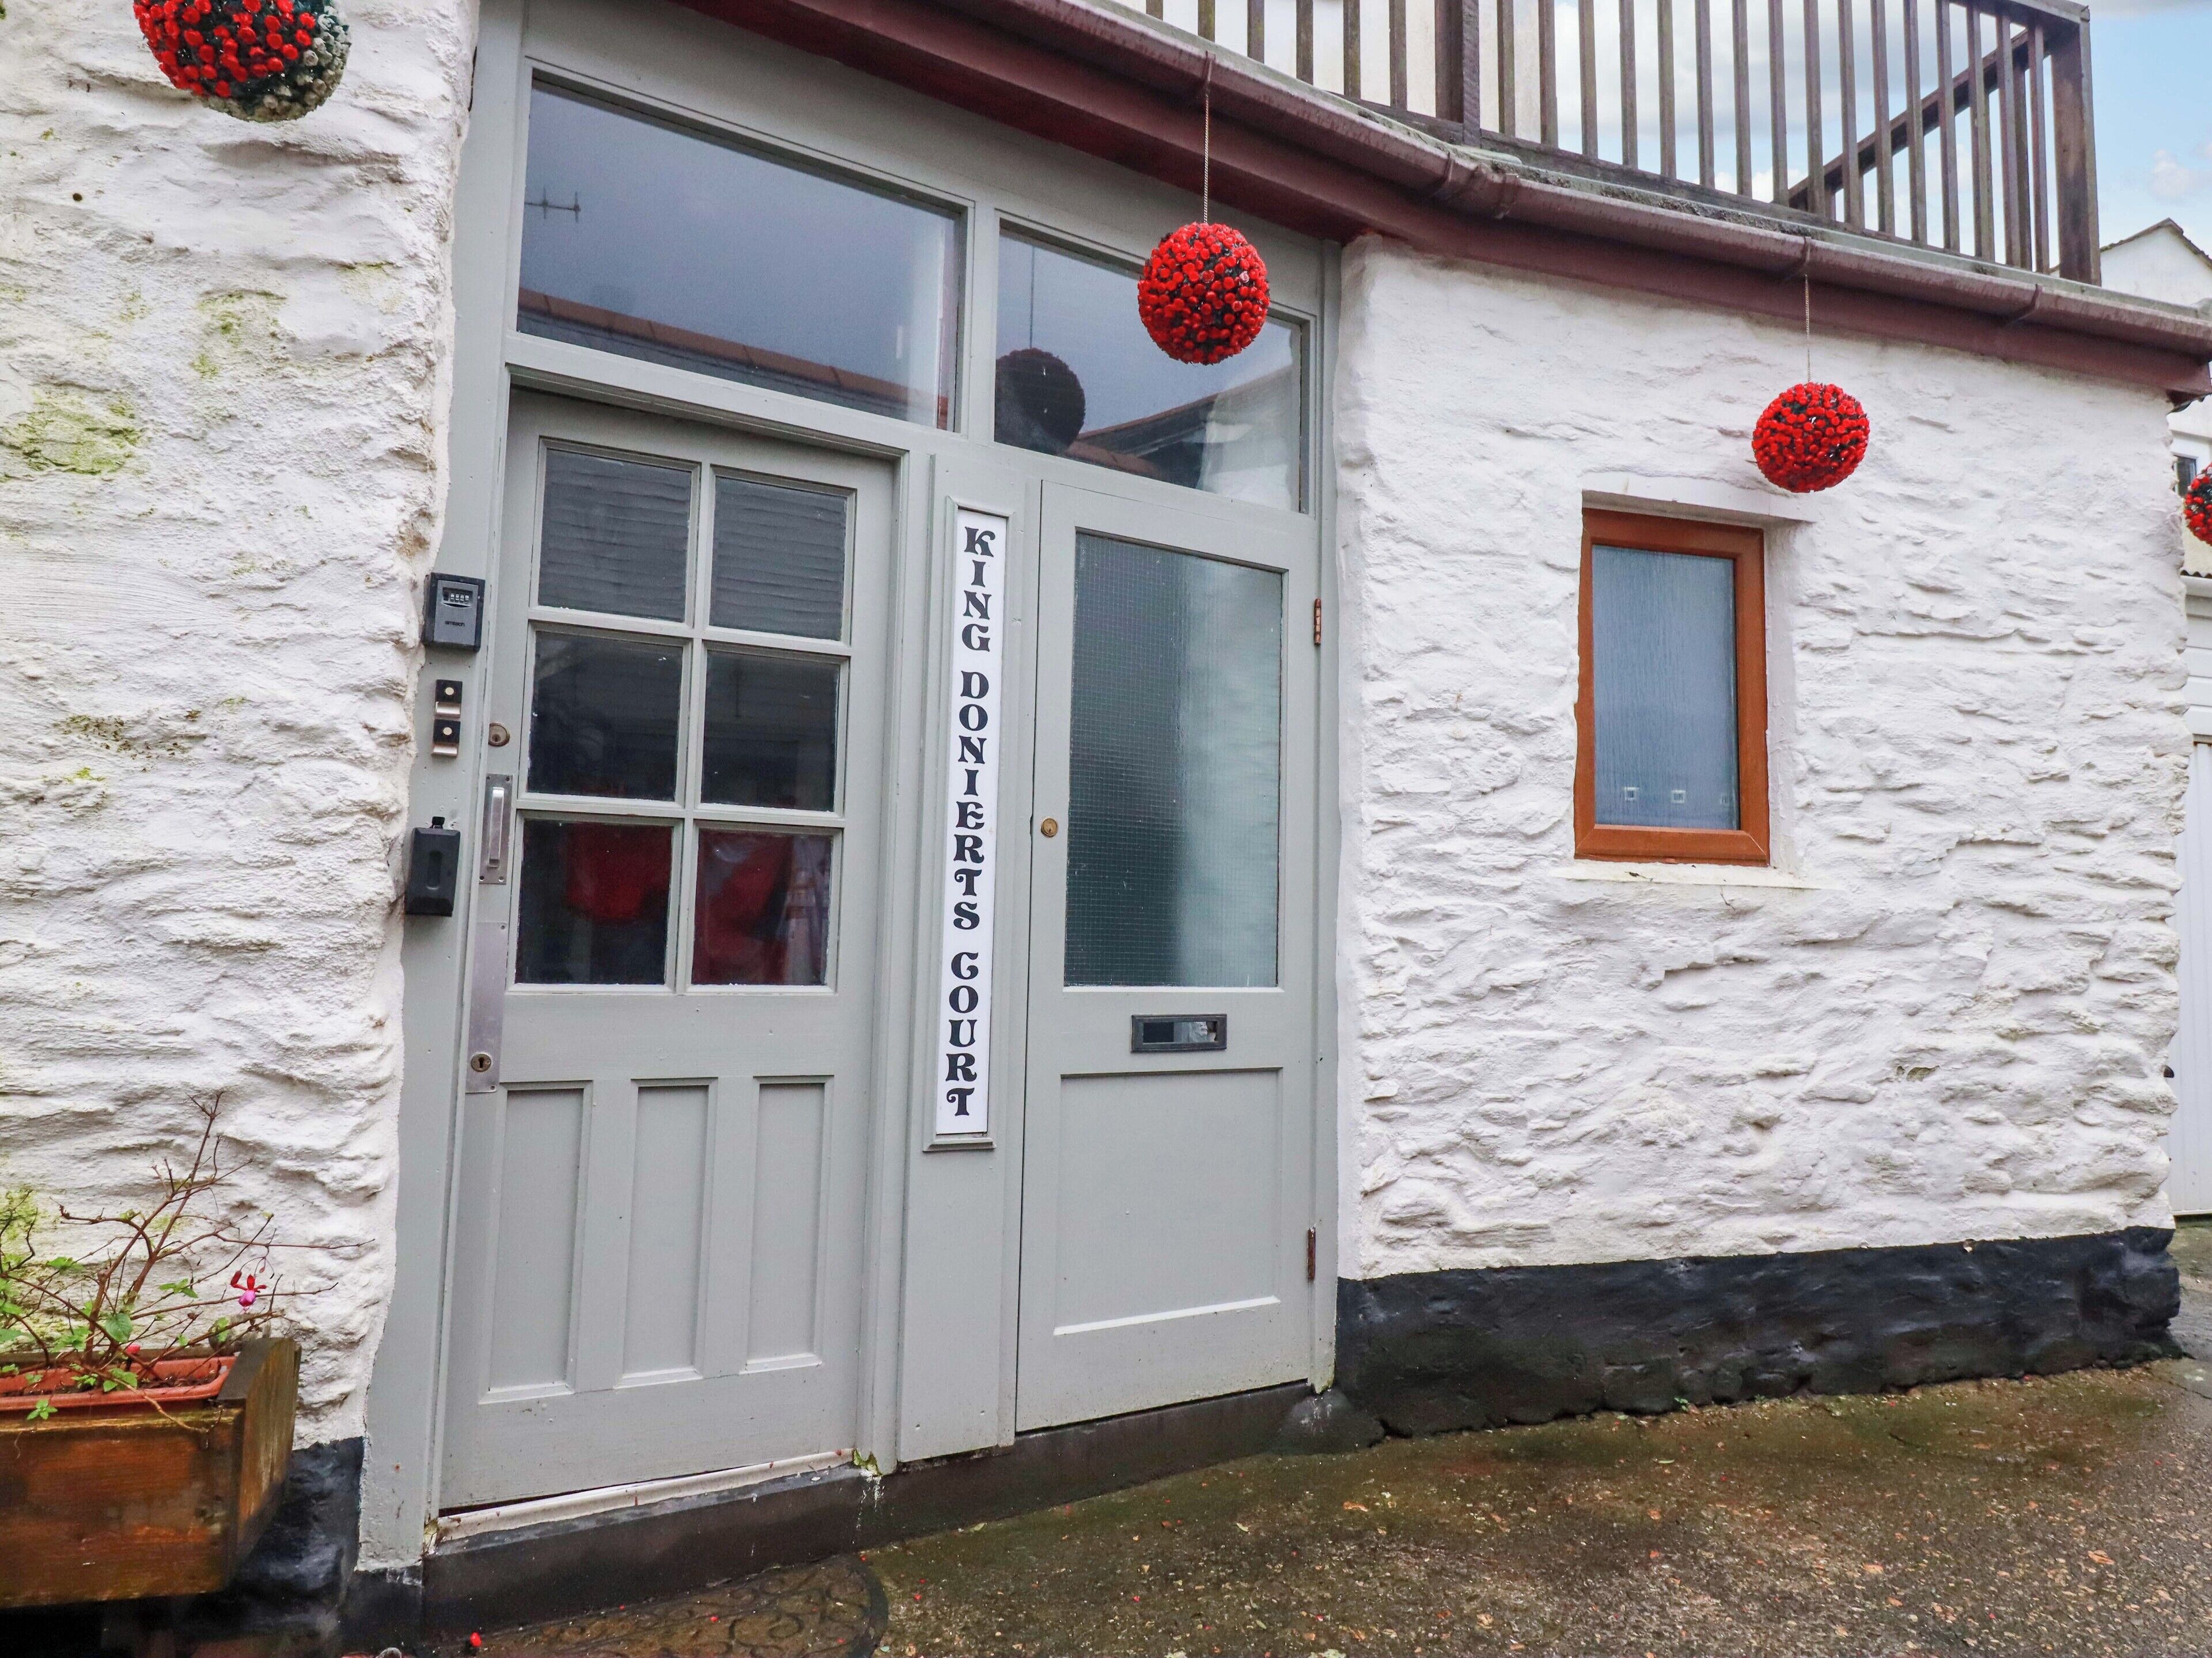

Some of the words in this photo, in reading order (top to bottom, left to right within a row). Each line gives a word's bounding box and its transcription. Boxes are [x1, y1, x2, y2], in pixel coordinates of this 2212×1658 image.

[961, 526, 997, 652] KING
[952, 670, 990, 931] DONIERTS
[945, 951, 979, 1117] COURT
